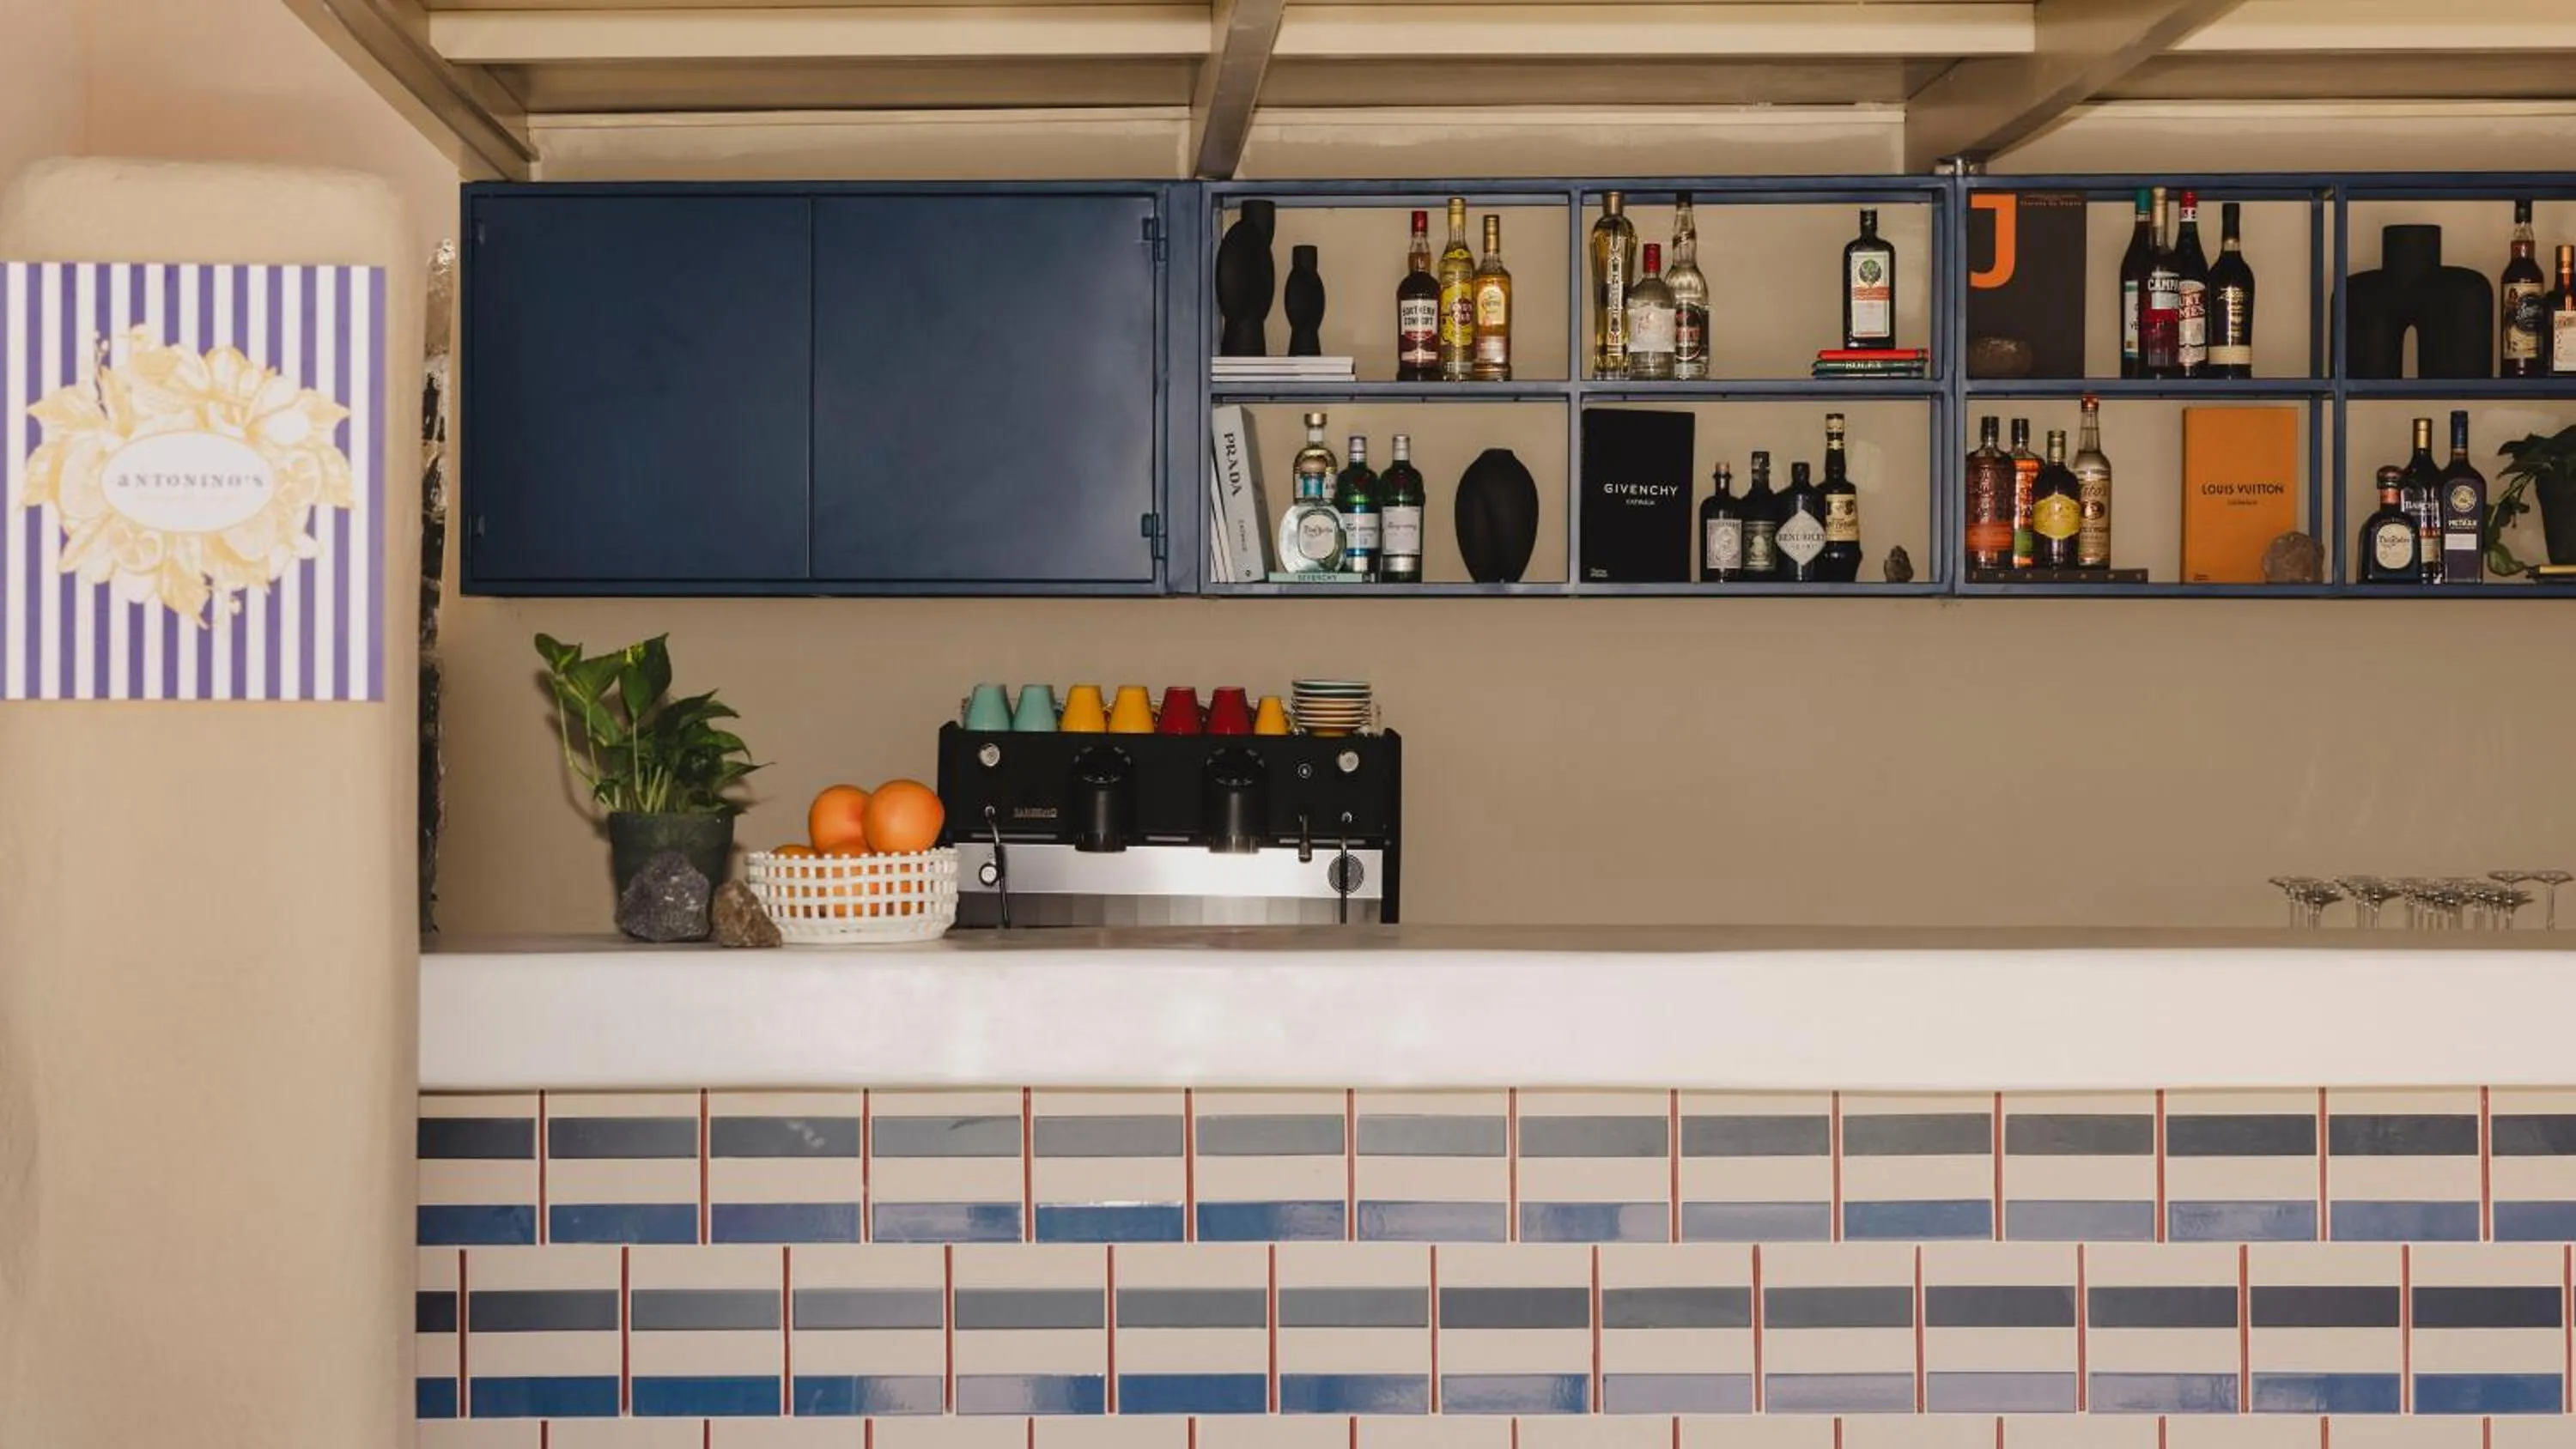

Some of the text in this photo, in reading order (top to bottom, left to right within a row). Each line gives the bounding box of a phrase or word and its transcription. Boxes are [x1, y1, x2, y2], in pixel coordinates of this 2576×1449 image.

[1969, 193, 2017, 288] J
[2179, 293, 2202, 306] UNT
[1223, 432, 1243, 498] PRADA
[1603, 482, 1679, 496] GIVENCHY
[2201, 482, 2284, 495] LOUIS VUITTON
